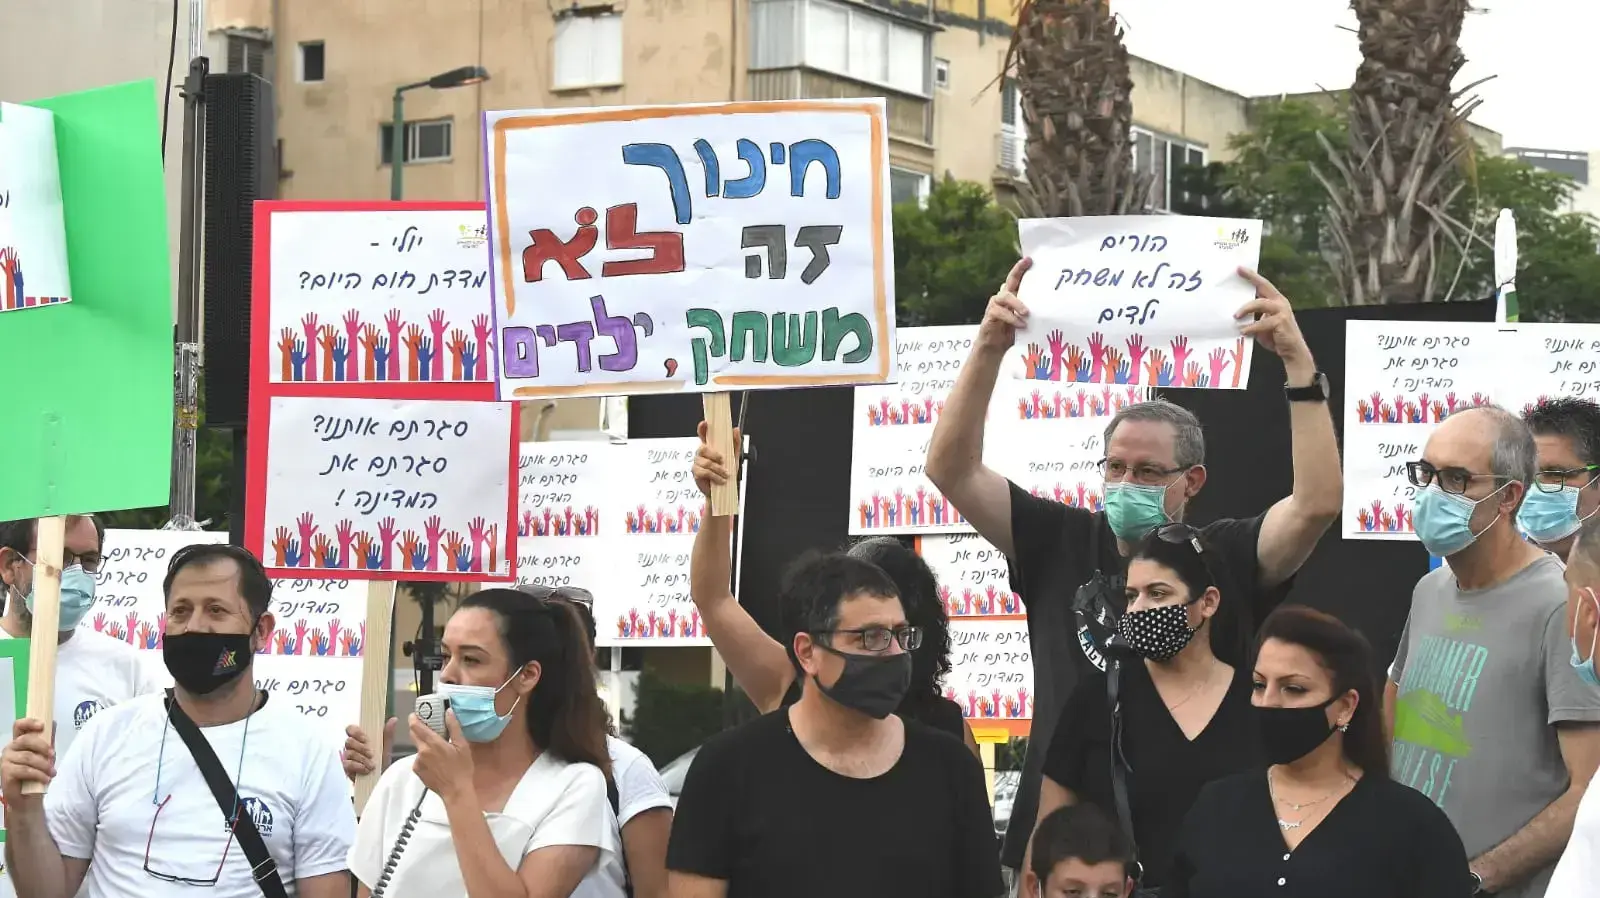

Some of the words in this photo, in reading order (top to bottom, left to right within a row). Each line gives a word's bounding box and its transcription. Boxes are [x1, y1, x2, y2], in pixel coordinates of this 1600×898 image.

[622, 138, 841, 224] חינוך
[392, 226, 423, 252] יולי
[1100, 234, 1168, 252] הורים
[741, 224, 843, 285] זה
[299, 271, 362, 290] היום?
[372, 270, 416, 290] חום
[417, 269, 487, 295] מדדת
[1054, 267, 1125, 290] משחק
[1131, 262, 1171, 289] לא
[1168, 270, 1203, 292] זה
[1097, 298, 1160, 326] ילדים
[503, 295, 653, 378] ילדים
[1377, 334, 1418, 350] אותנו?
[1422, 336, 1470, 350] סגרתם
[664, 307, 873, 385] משחק,
[928, 339, 972, 354] סגרתם
[1544, 337, 1585, 354] אותנו?
[917, 360, 961, 374] סגרתם
[1383, 356, 1406, 371] את
[1410, 357, 1459, 371] סגרתם
[1549, 359, 1573, 374] את
[1404, 377, 1454, 393] המדינה
[313, 414, 380, 442] אותנו?
[388, 420, 469, 441] סגרתם
[1081, 434, 1099, 450] יולי
[647, 450, 681, 464] אותנו?
[1378, 443, 1418, 459] אותנו?
[318, 453, 358, 476] את
[367, 454, 448, 477] סגרתם
[549, 453, 588, 468] סגרתם
[1028, 461, 1065, 472] היום?
[1069, 460, 1095, 472] חום
[649, 469, 669, 483] את
[868, 466, 904, 478] היום?
[909, 463, 926, 476] ום
[1383, 465, 1406, 479] את
[518, 474, 536, 487] את
[539, 473, 578, 488] סגרתם
[354, 489, 438, 515] המדינה
[532, 492, 572, 508] המדינה
[543, 555, 581, 569] סגרתם
[950, 549, 972, 564] את
[640, 573, 660, 587] את
[278, 600, 340, 618] המדינה
[952, 631, 990, 646] אותנו?
[995, 631, 1029, 645] גרתם
[956, 651, 979, 666] את
[984, 652, 1029, 666] סגרתם
[286, 680, 346, 695] סגרתם
[977, 672, 1025, 688] המדינה
